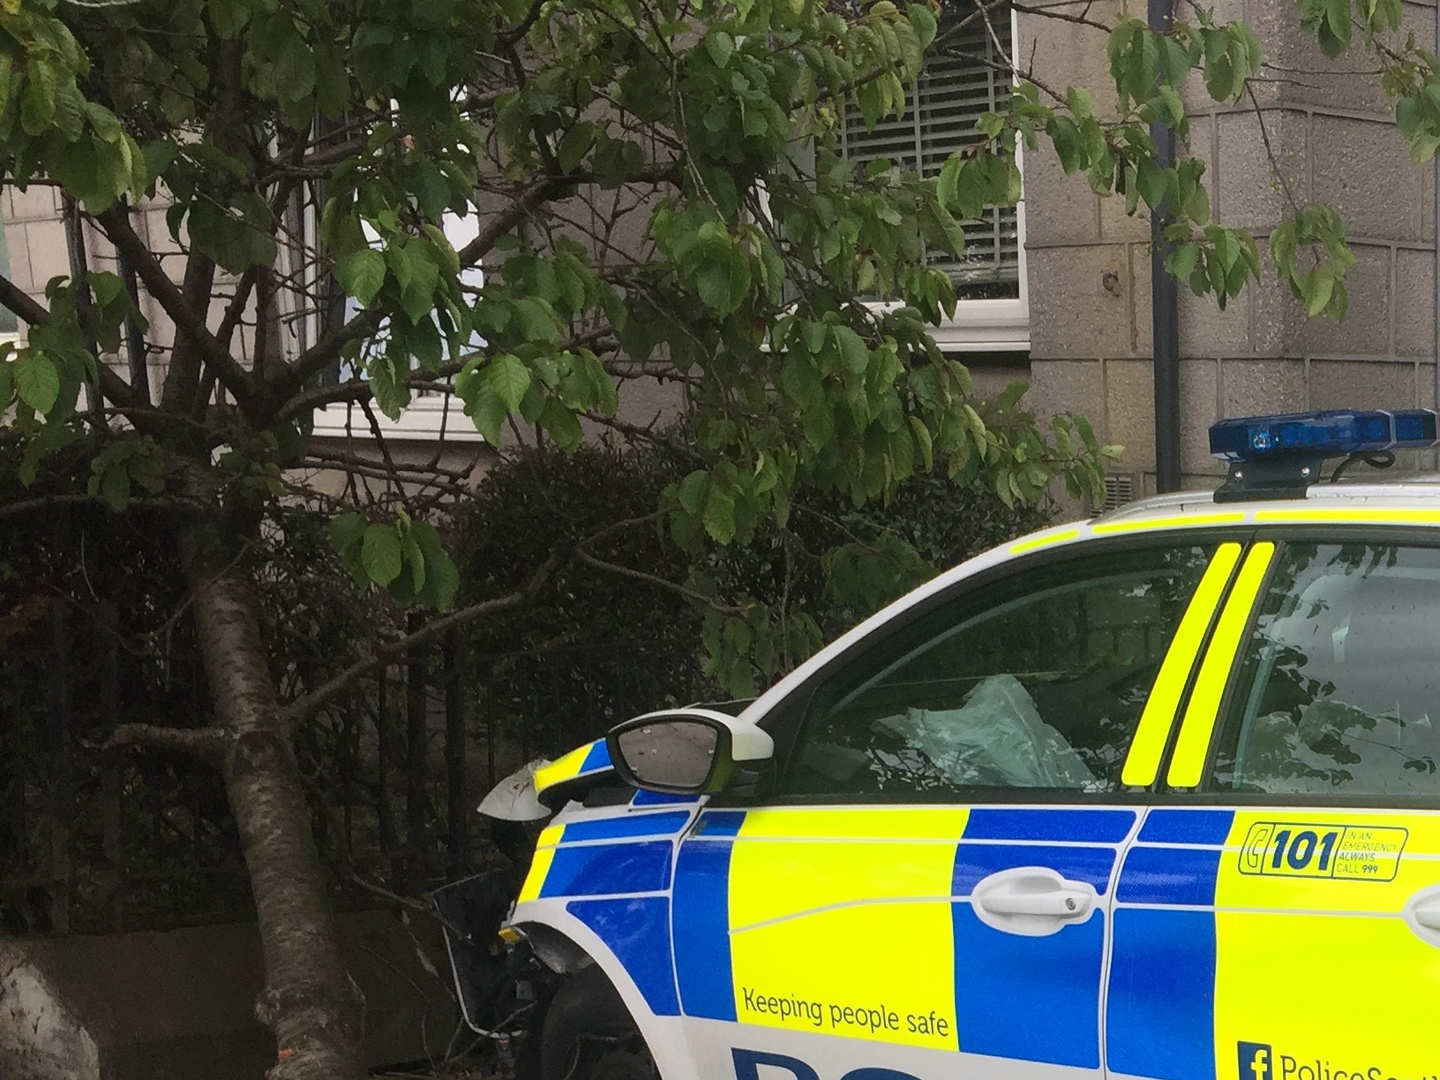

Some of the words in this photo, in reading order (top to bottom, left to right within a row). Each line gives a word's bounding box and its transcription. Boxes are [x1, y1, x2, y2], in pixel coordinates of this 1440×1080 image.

[1347, 832, 1357, 840] IN
[1359, 832, 1373, 841] AN
[1272, 830, 1338, 870] 101
[1342, 841, 1399, 852] EMERGENCY
[1338, 852, 1376, 862] ALWAYS
[1336, 863, 1360, 874] CALL
[1362, 864, 1378, 875] 999
[742, 986, 823, 1027] Keeping
[828, 1004, 900, 1034] people
[906, 1011, 949, 1037] safe
